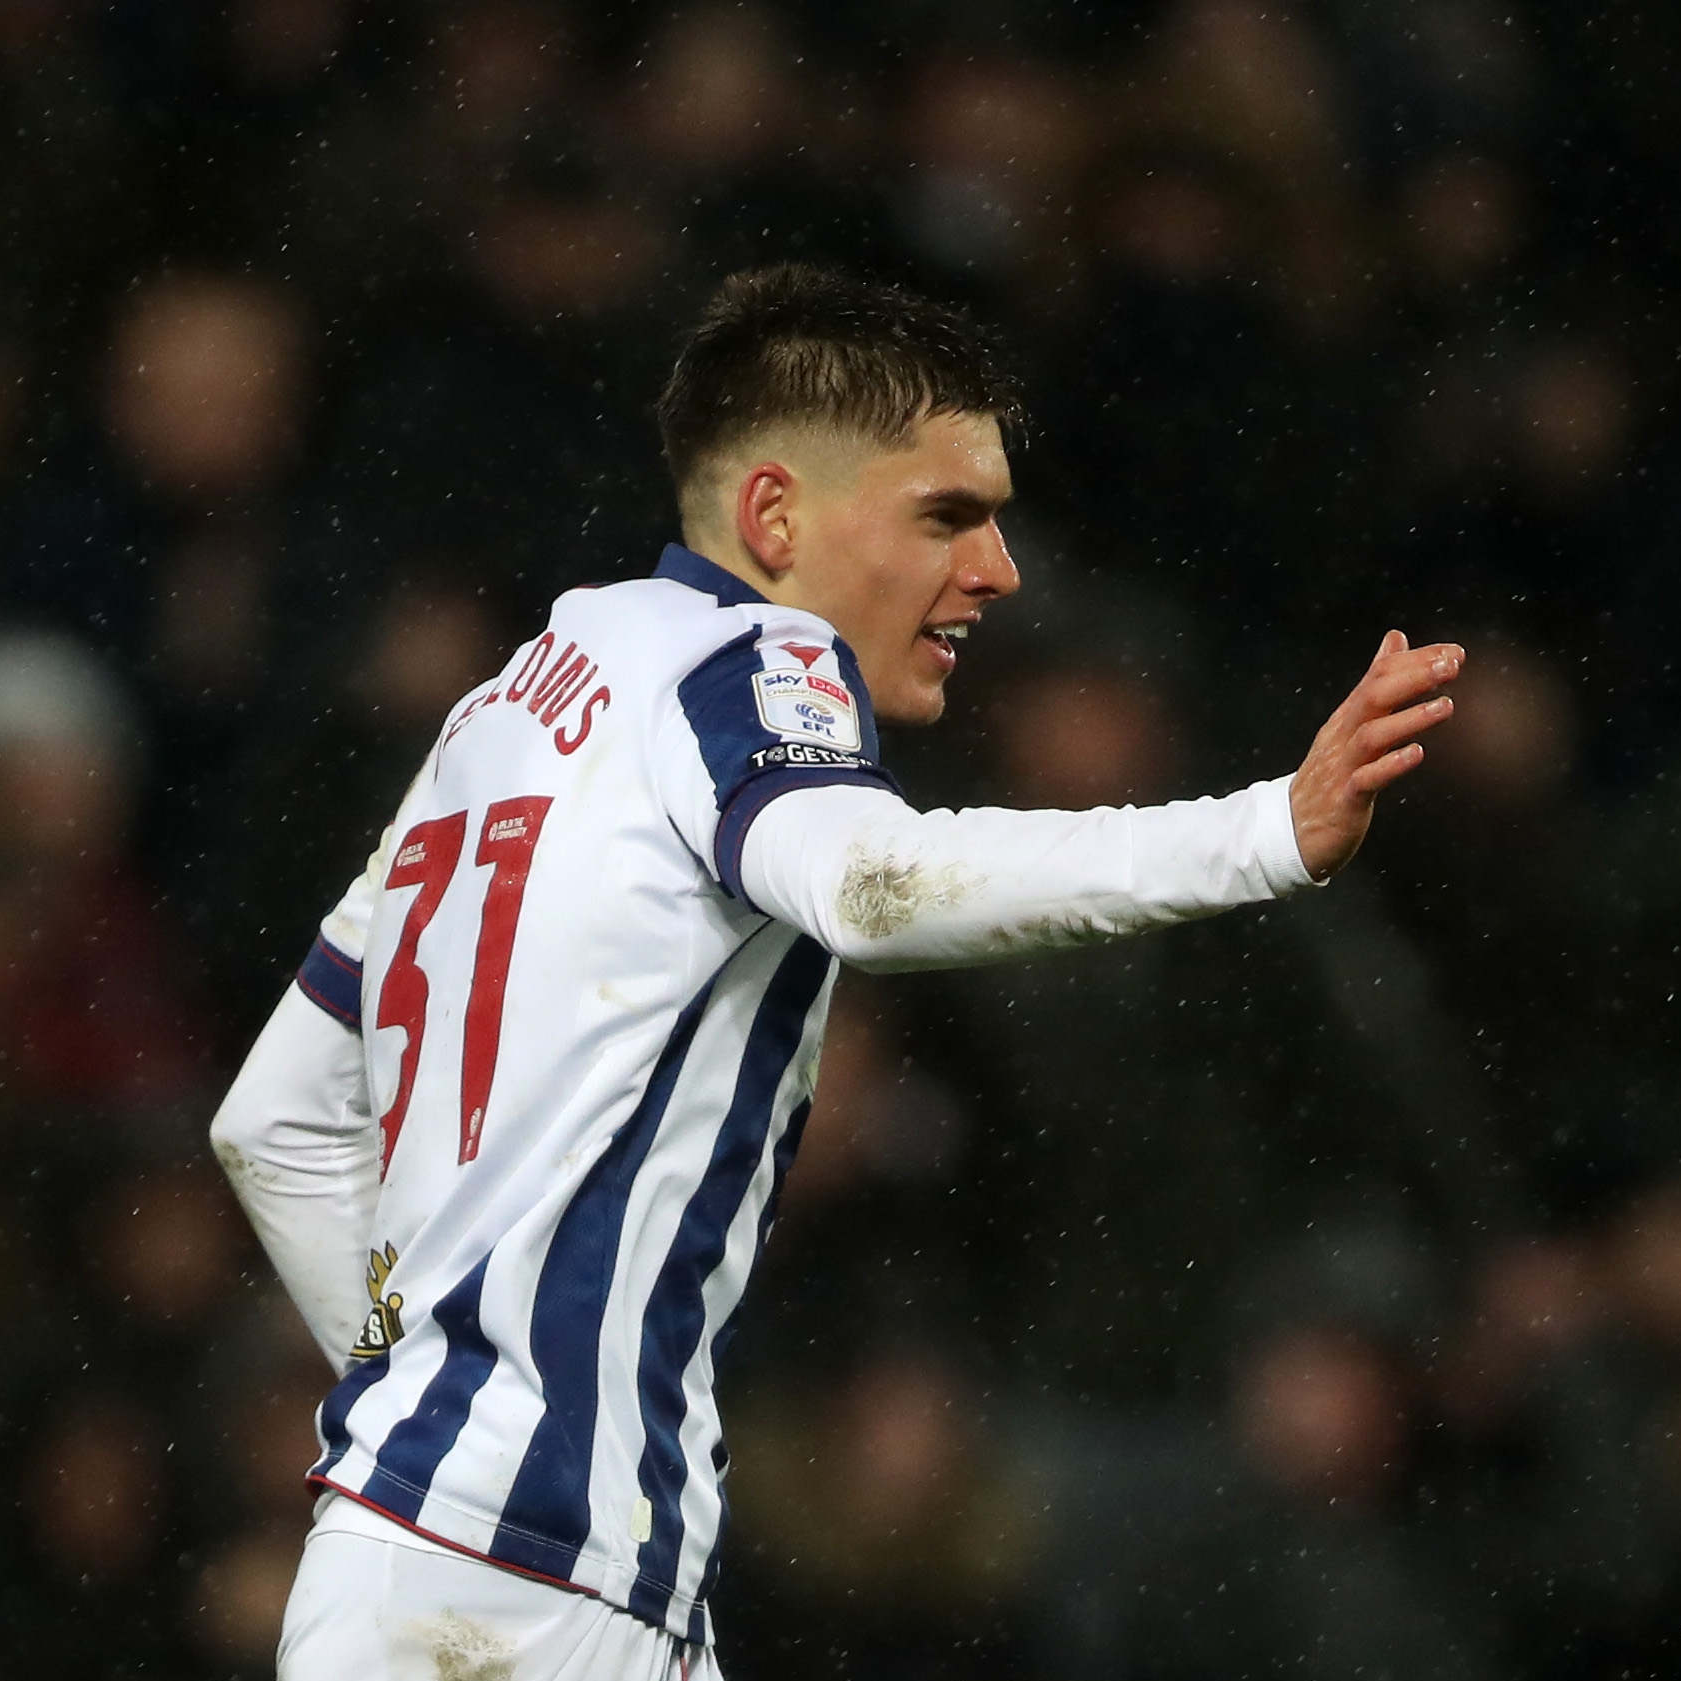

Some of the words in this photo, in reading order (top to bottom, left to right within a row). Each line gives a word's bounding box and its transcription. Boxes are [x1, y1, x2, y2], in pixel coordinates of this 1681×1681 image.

[434, 631, 611, 785] LOWS
[764, 674, 803, 686] sky
[812, 677, 850, 704] bet
[802, 721, 836, 738] EFL
[375, 795, 556, 1185] 31
